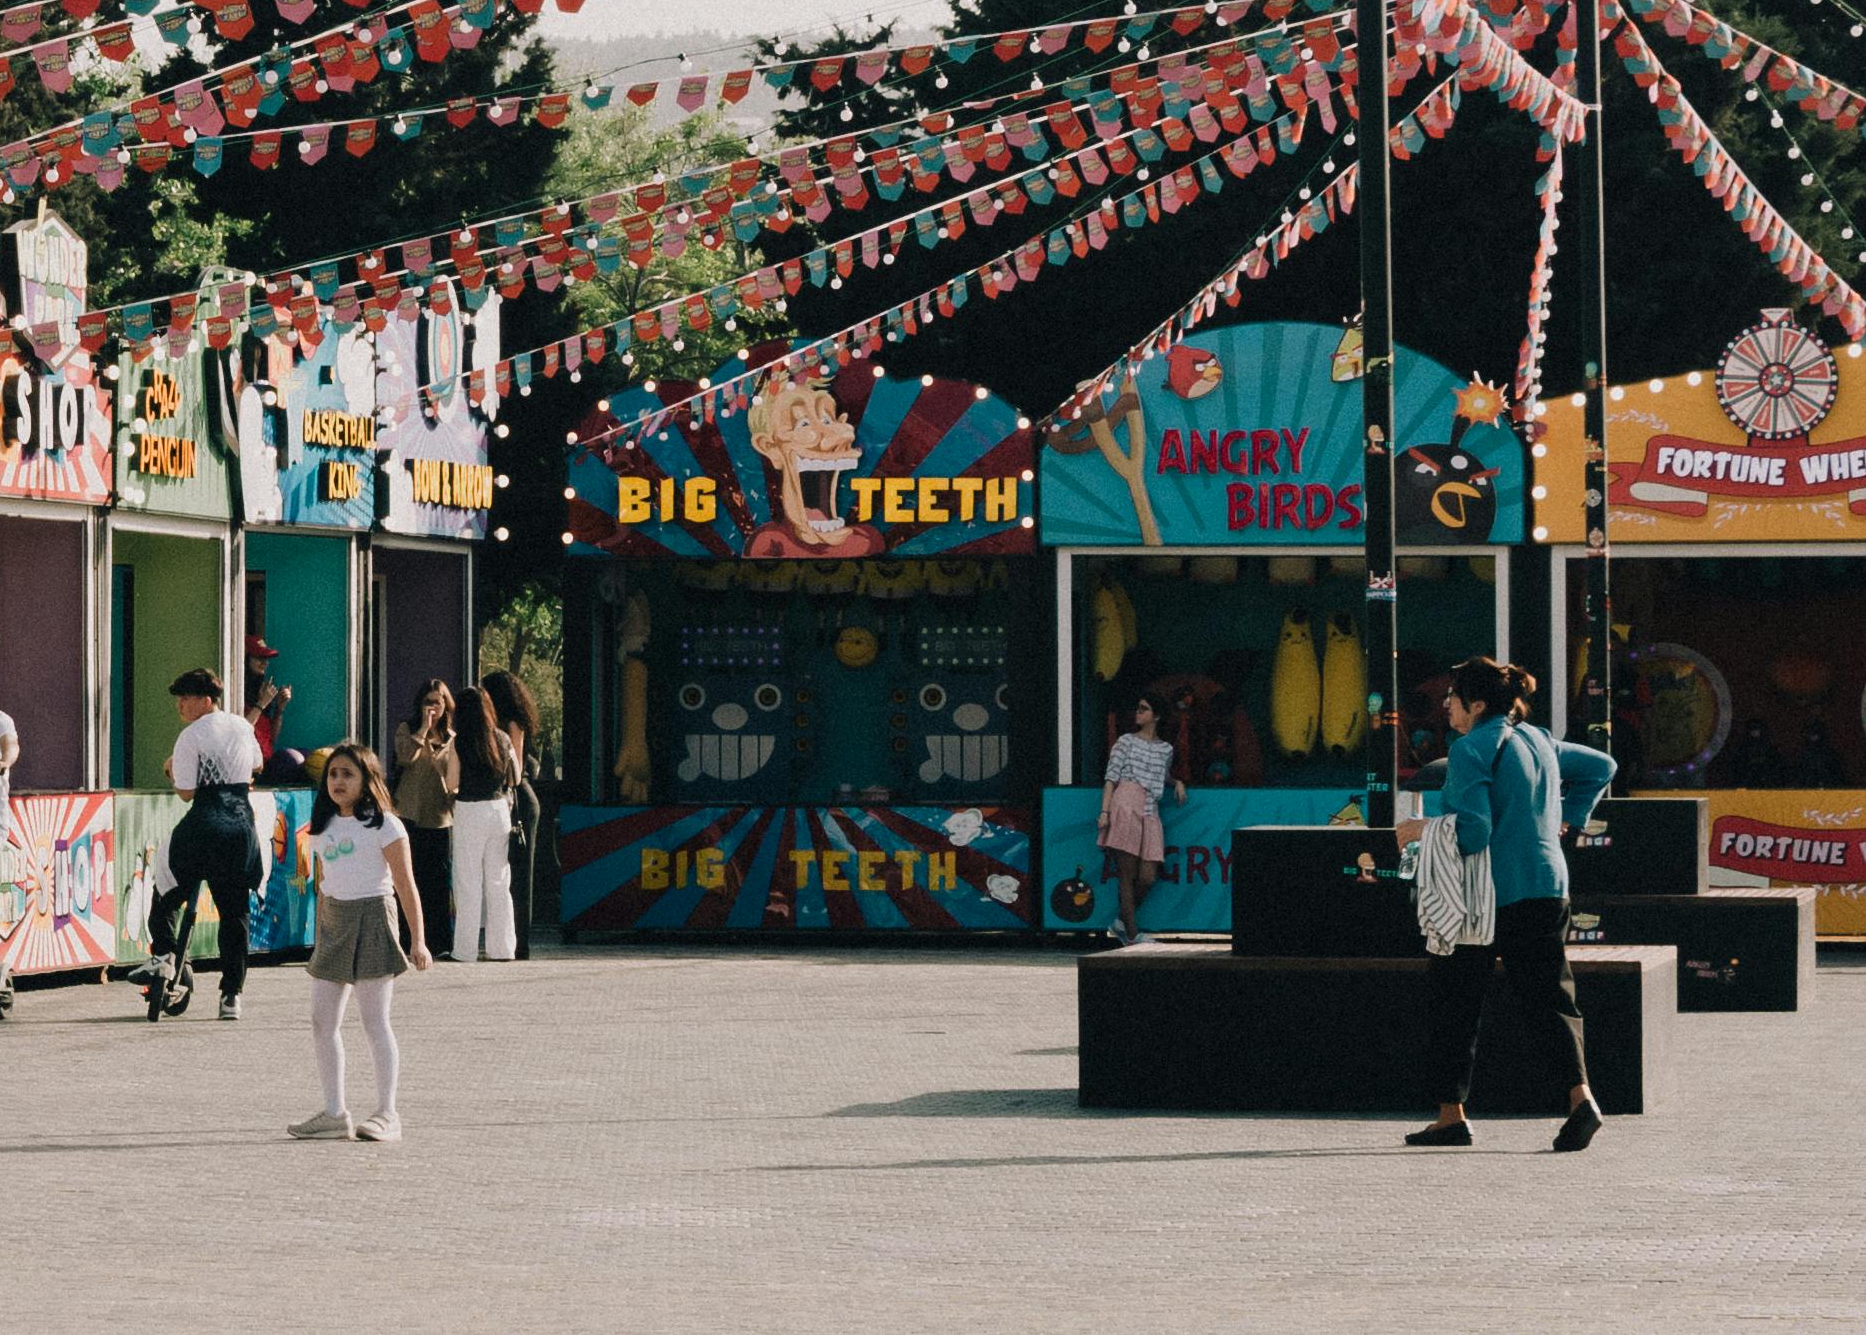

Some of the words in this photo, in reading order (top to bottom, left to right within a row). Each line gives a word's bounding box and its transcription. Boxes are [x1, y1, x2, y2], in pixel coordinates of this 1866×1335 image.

[16, 370, 97, 452] SHOP
[303, 409, 376, 450] BASKETBALL
[139, 433, 197, 479] PENGUIN
[1156, 426, 1311, 477] ANGRY
[1656, 446, 1787, 486] FORTUNE
[328, 460, 362, 500] KING
[618, 476, 717, 524] BIG
[850, 476, 1019, 524] TEETH
[1226, 481, 1362, 532] BIRDS
[639, 847, 725, 891] BIG
[790, 849, 958, 892] TEETH
[1100, 844, 1233, 885] AGRY
[1719, 832, 1847, 865] FORTUNE
[35, 839, 107, 915] SHOP
